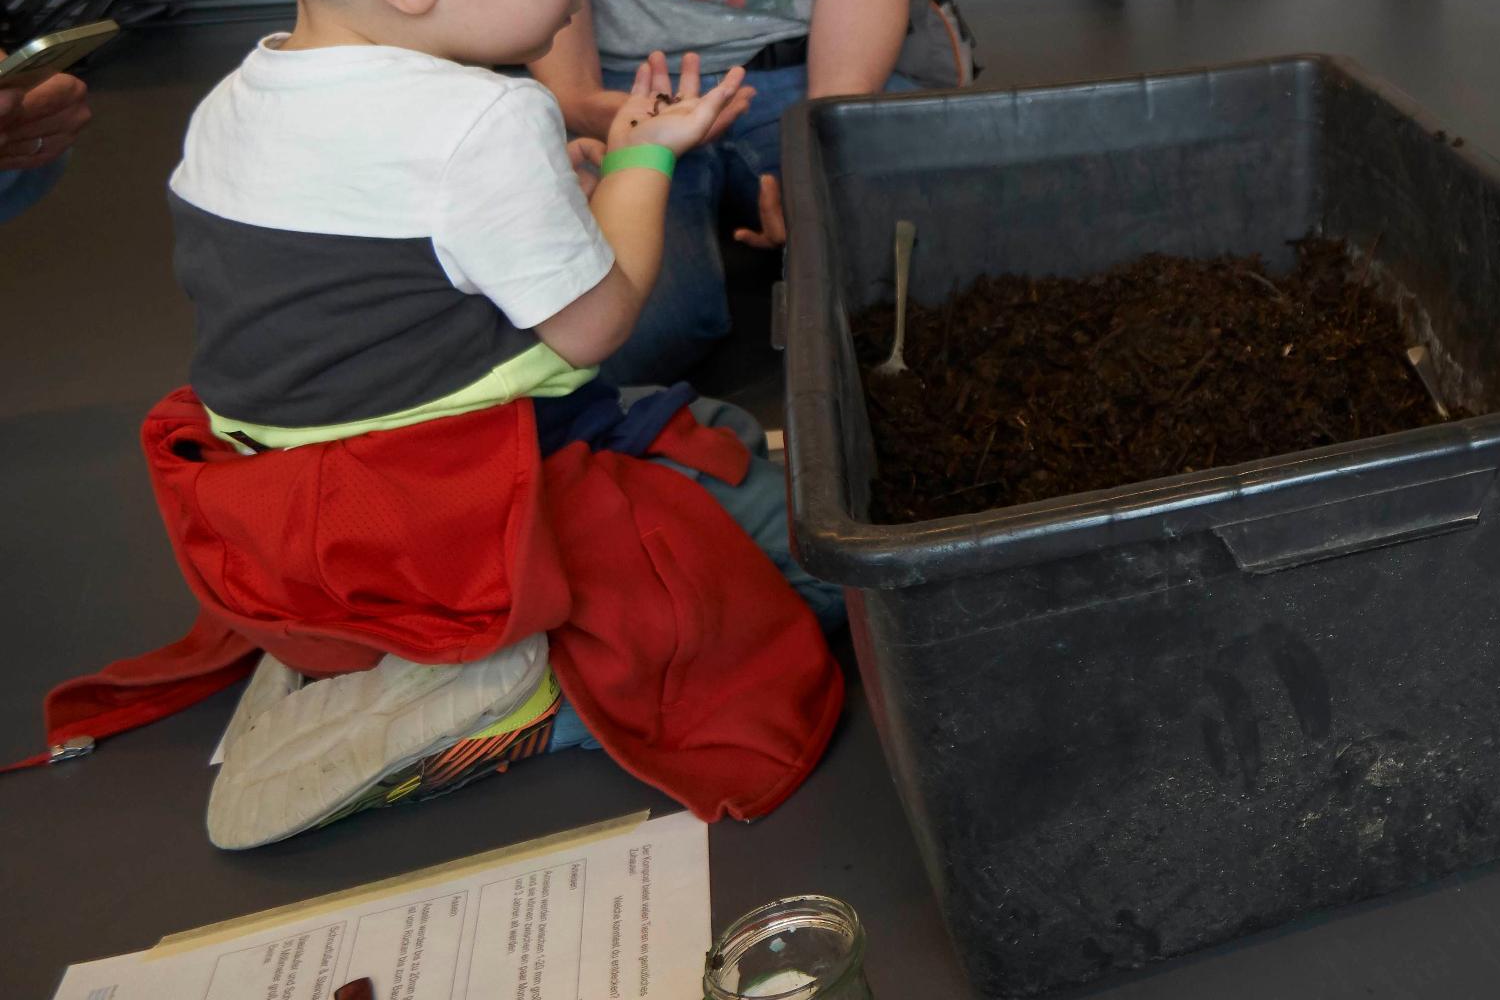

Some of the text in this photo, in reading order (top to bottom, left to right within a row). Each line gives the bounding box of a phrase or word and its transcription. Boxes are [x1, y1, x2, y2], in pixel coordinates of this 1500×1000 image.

[640, 856, 652, 883] Kompost
[540, 898, 550, 922] werden
[612, 896, 624, 919] Welche
[414, 925, 428, 949] werden
[640, 921, 651, 942] Tieren
[611, 949, 622, 959] du
[641, 943, 650, 955] ein
[609, 960, 622, 999] entdecken?
